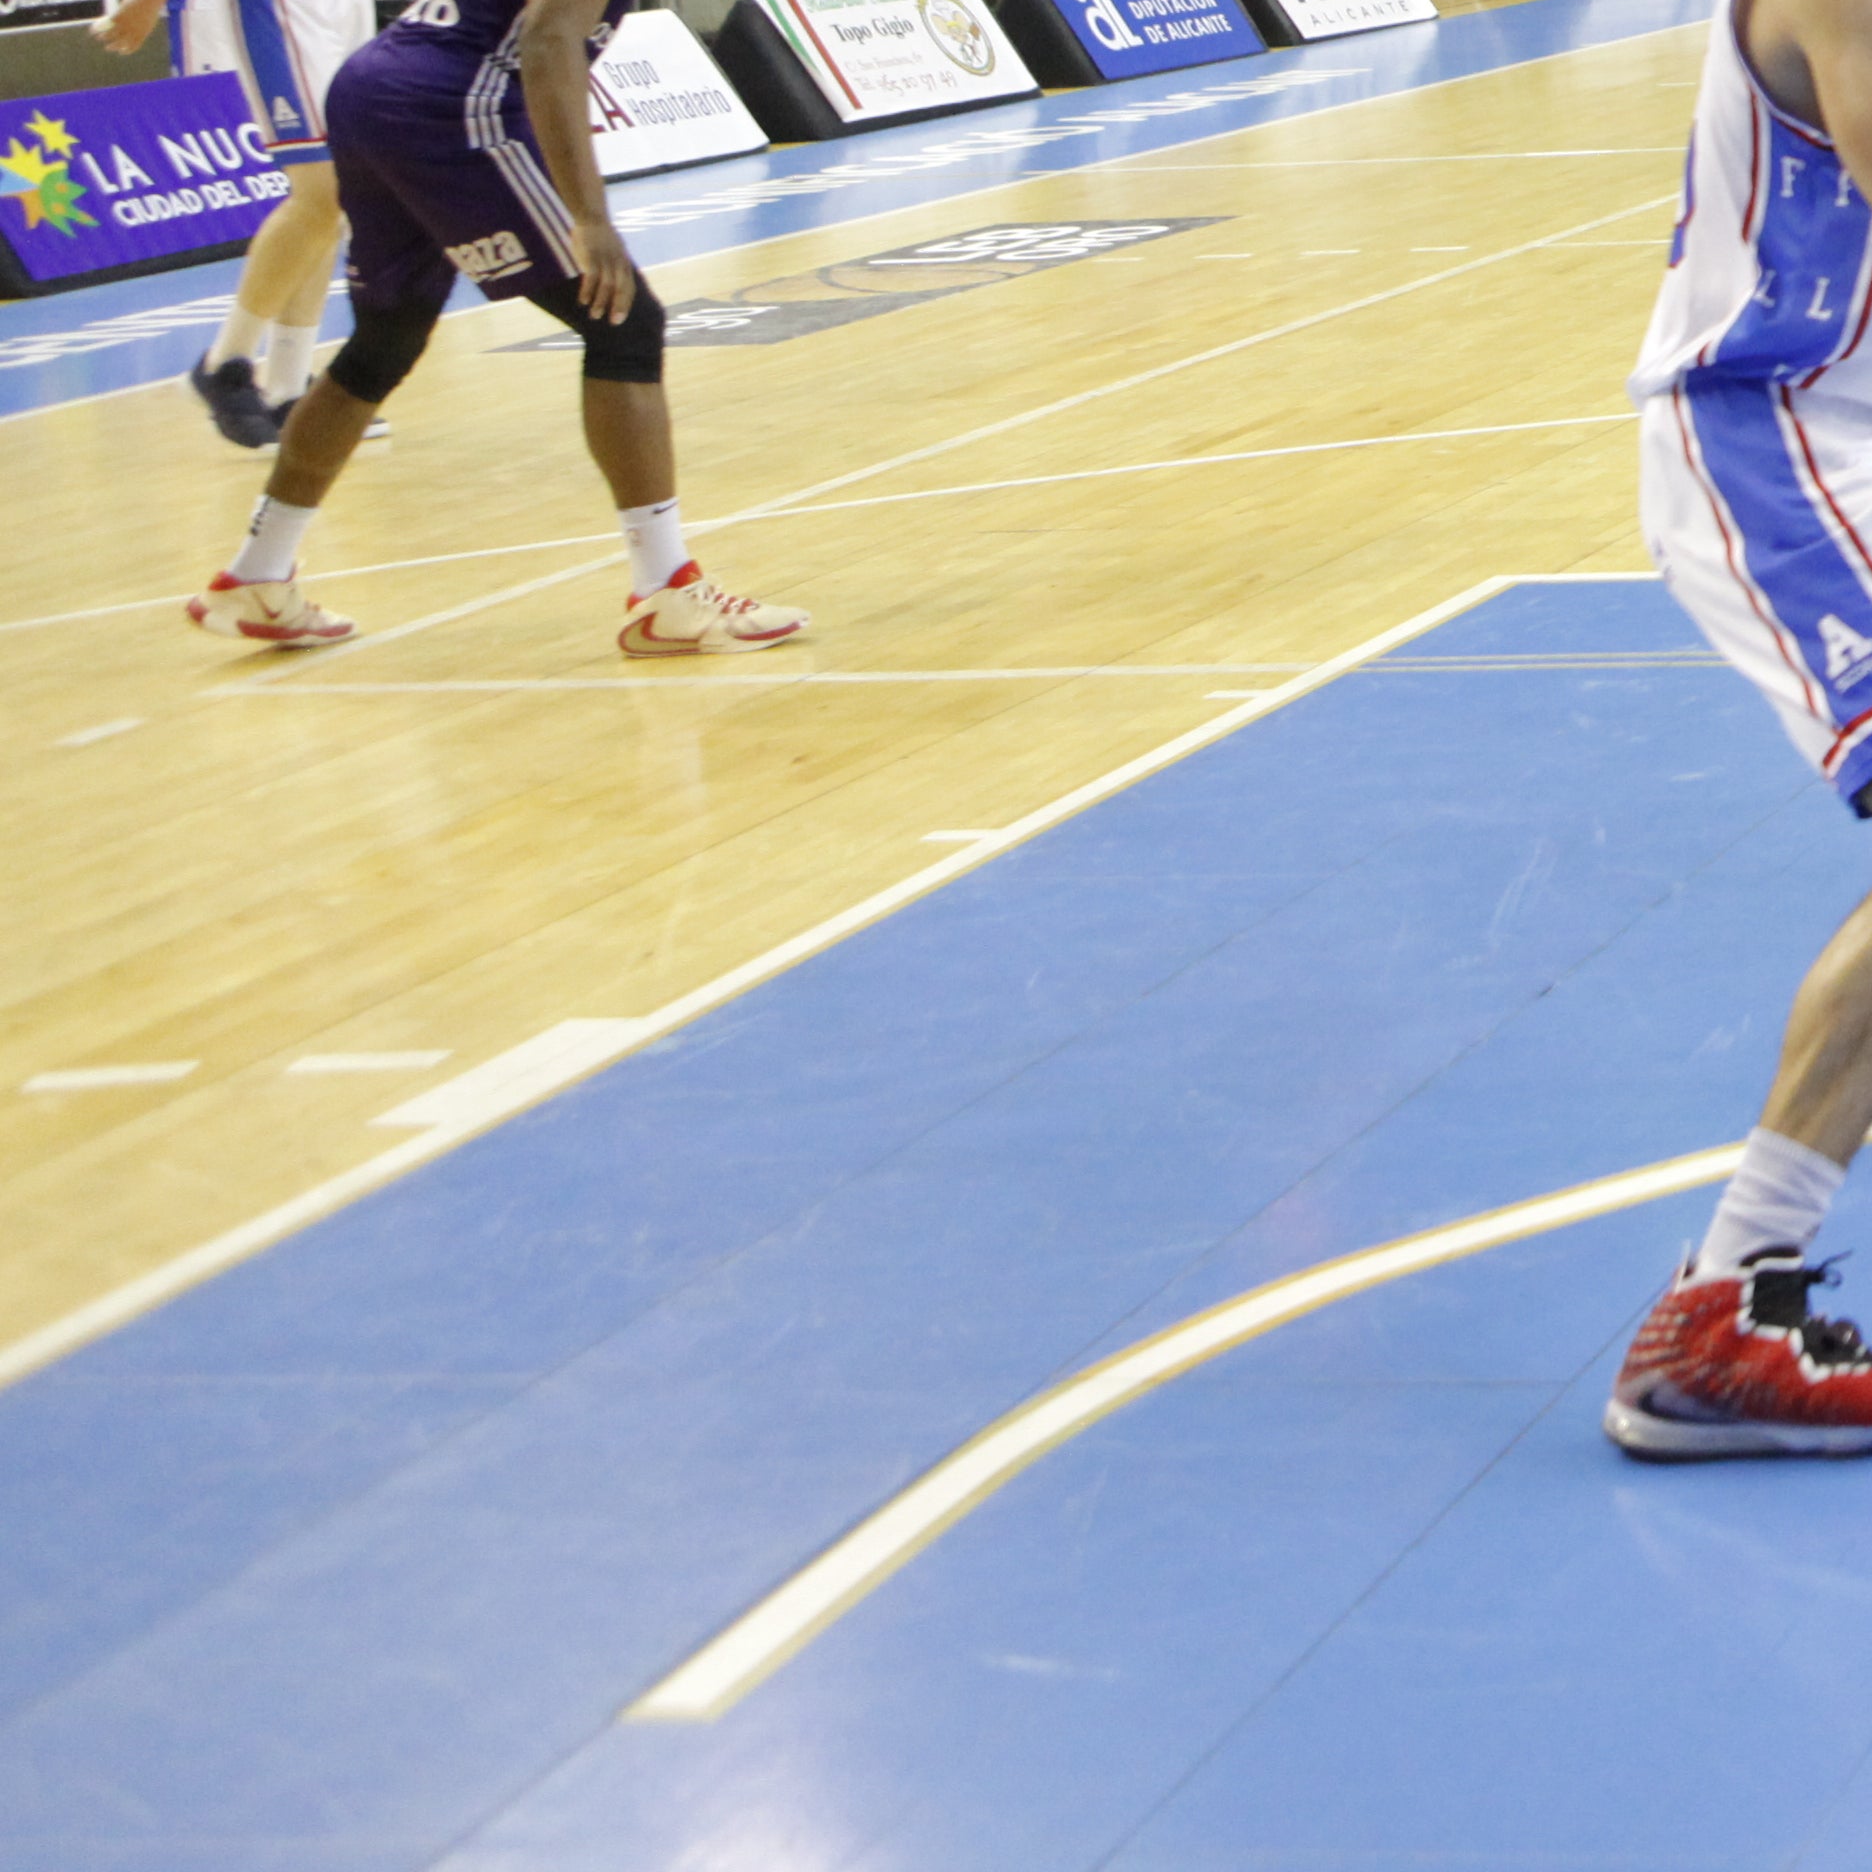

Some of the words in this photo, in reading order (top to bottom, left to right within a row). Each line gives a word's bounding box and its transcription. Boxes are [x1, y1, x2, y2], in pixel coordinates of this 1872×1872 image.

[831, 22, 873, 46] Topo
[870, 15, 916, 40] Gigio
[1143, 24, 1170, 45] DE
[1166, 13, 1233, 42] ALICANTE
[1310, 0, 1411, 27] ALICANTE
[604, 56, 658, 91] Grupo
[629, 85, 733, 129] Hospitalario
[81, 144, 155, 196] LA
[112, 187, 204, 227] CIUDAD
[200, 178, 251, 211] DEL
